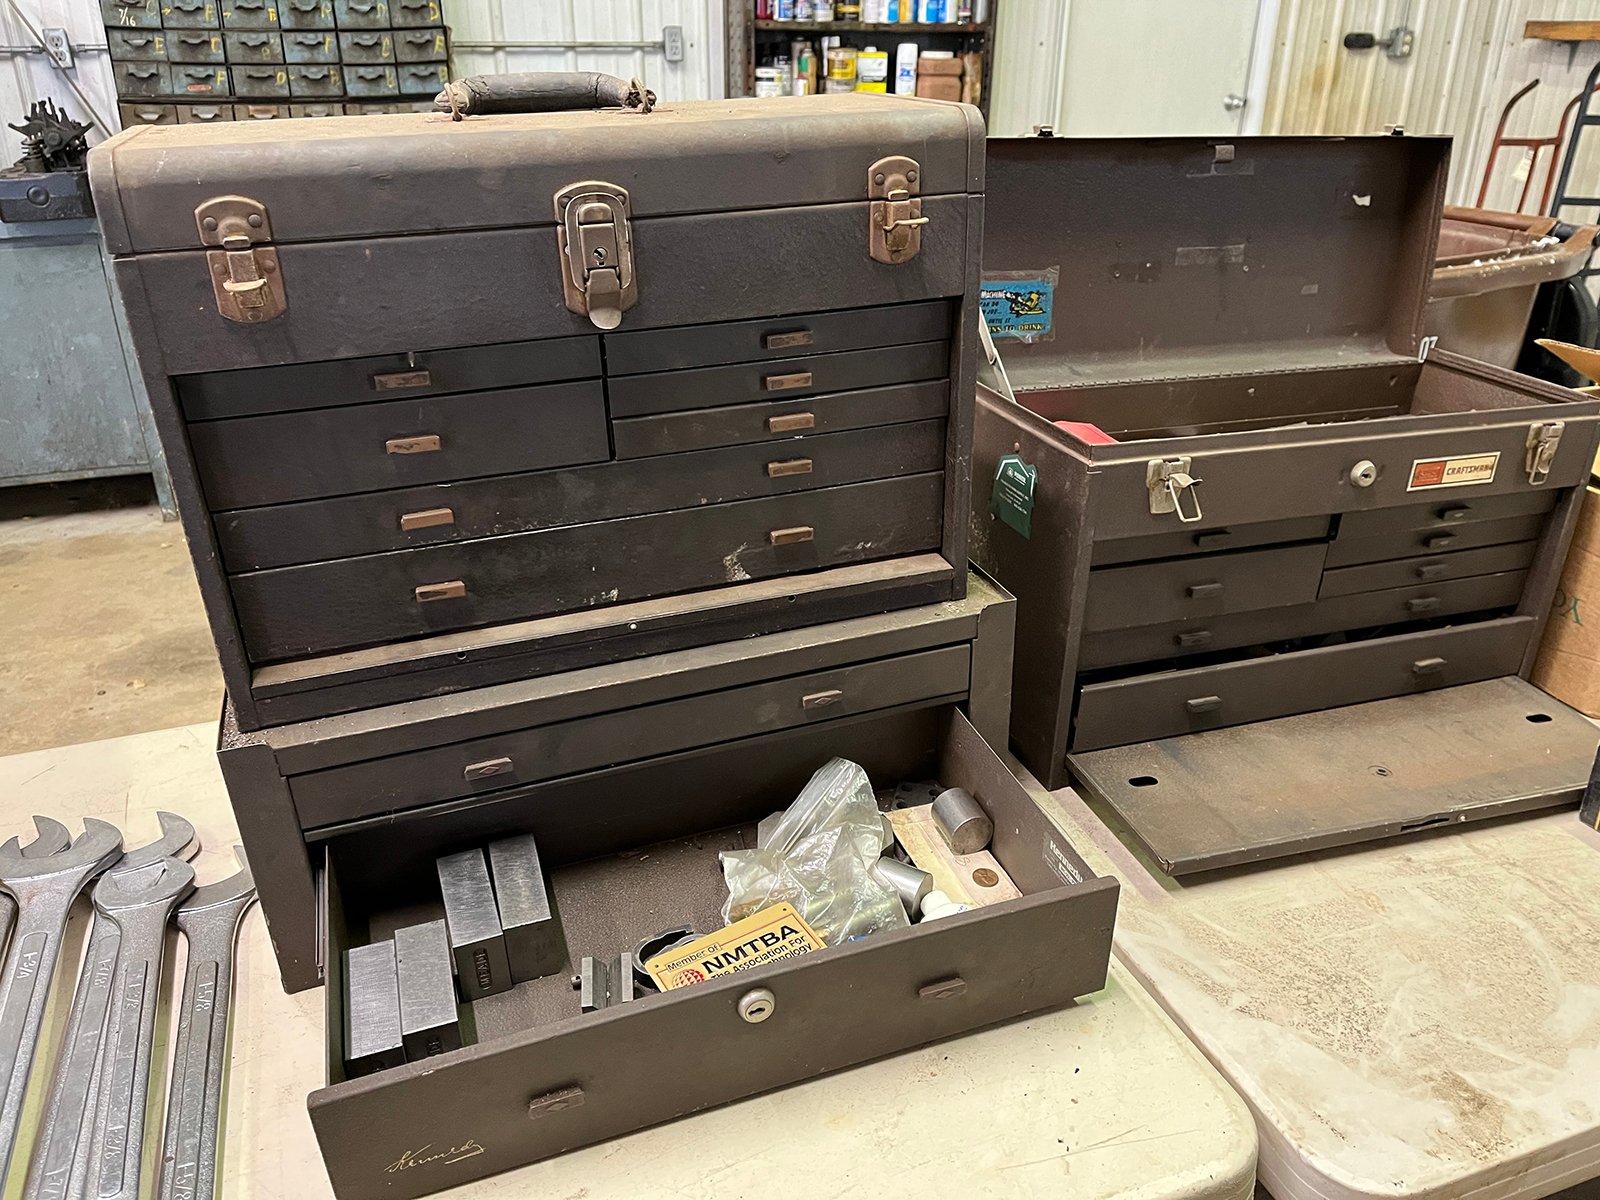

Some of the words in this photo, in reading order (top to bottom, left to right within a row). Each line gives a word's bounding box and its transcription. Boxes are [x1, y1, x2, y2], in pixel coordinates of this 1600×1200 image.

[119, 7, 136, 27] 7/16
[1446, 464, 1492, 476] CRAFTSMAN
[701, 925, 800, 974] NMTBA
[733, 945, 788, 973] Association
[788, 936, 805, 947] For
[667, 950, 706, 972] Member
